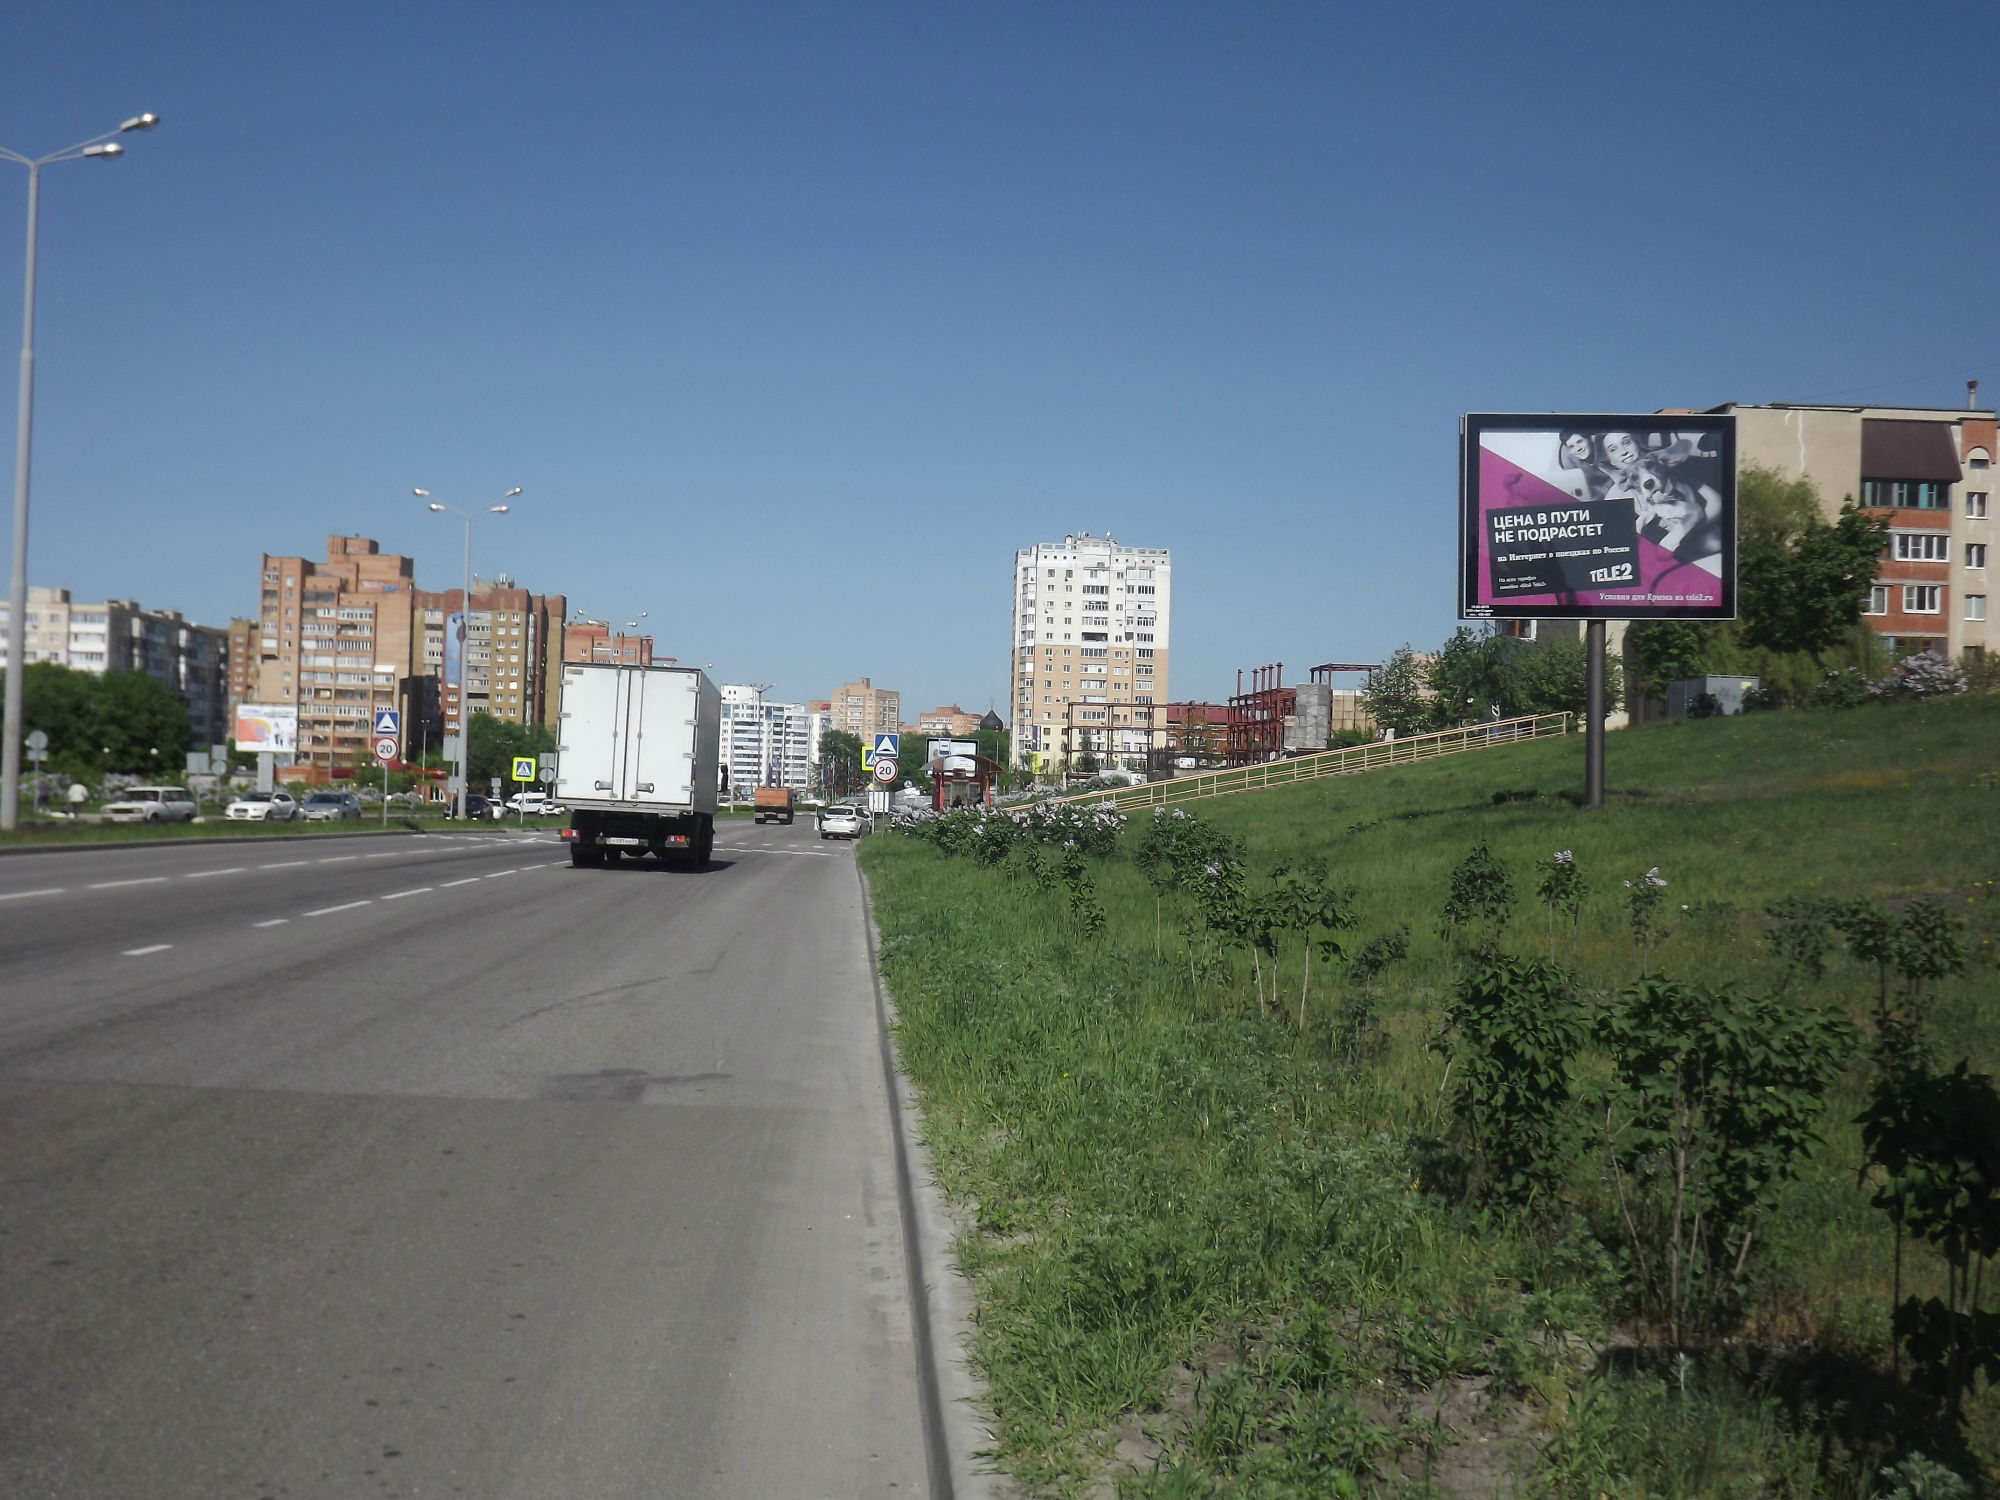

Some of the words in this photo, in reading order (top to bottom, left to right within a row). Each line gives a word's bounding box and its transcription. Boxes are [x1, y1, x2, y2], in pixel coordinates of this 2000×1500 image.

[1493, 513, 1534, 530] ЦЕНА
[1537, 512, 1547, 525] В
[1550, 509, 1590, 524] ПУТИ
[1495, 530, 1514, 543] НЕ
[1518, 523, 1604, 542] ПОДРАСТЕТ
[1509, 552, 1547, 562] Интернет
[1603, 546, 1630, 554] России
[1589, 562, 1633, 583] TELE2
[1599, 592, 1630, 601] Условия
[1631, 594, 1646, 602] для
[1647, 593, 1673, 603] Крыма
[1686, 593, 1714, 601] tele2.ru
[380, 744, 393, 754] 20
[879, 766, 892, 775] 20
